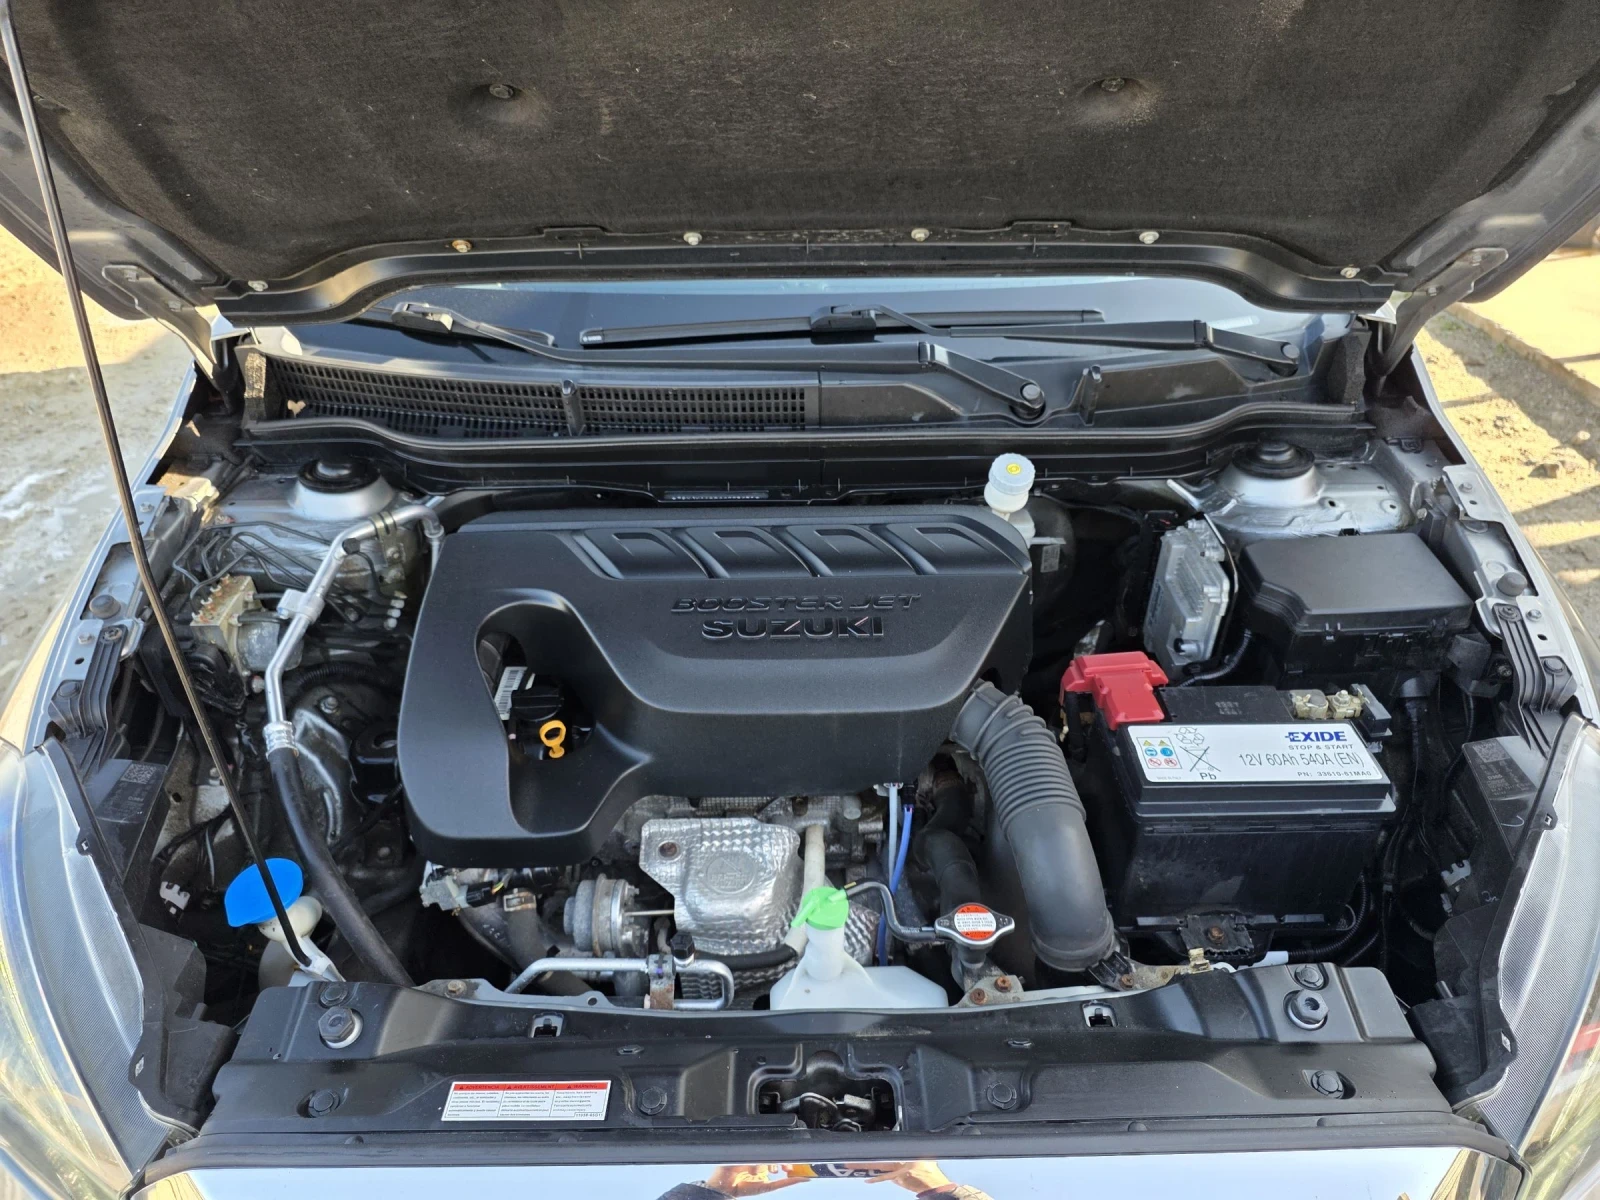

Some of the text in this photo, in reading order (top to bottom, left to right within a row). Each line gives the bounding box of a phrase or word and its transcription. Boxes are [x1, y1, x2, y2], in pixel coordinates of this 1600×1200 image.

[701, 616, 884, 639] SUZUKI
[1285, 731, 1347, 742] EXIDE
[1239, 752, 1365, 768] 12V 60Ah 540A (EN)
[1200, 772, 1217, 780] Pb
